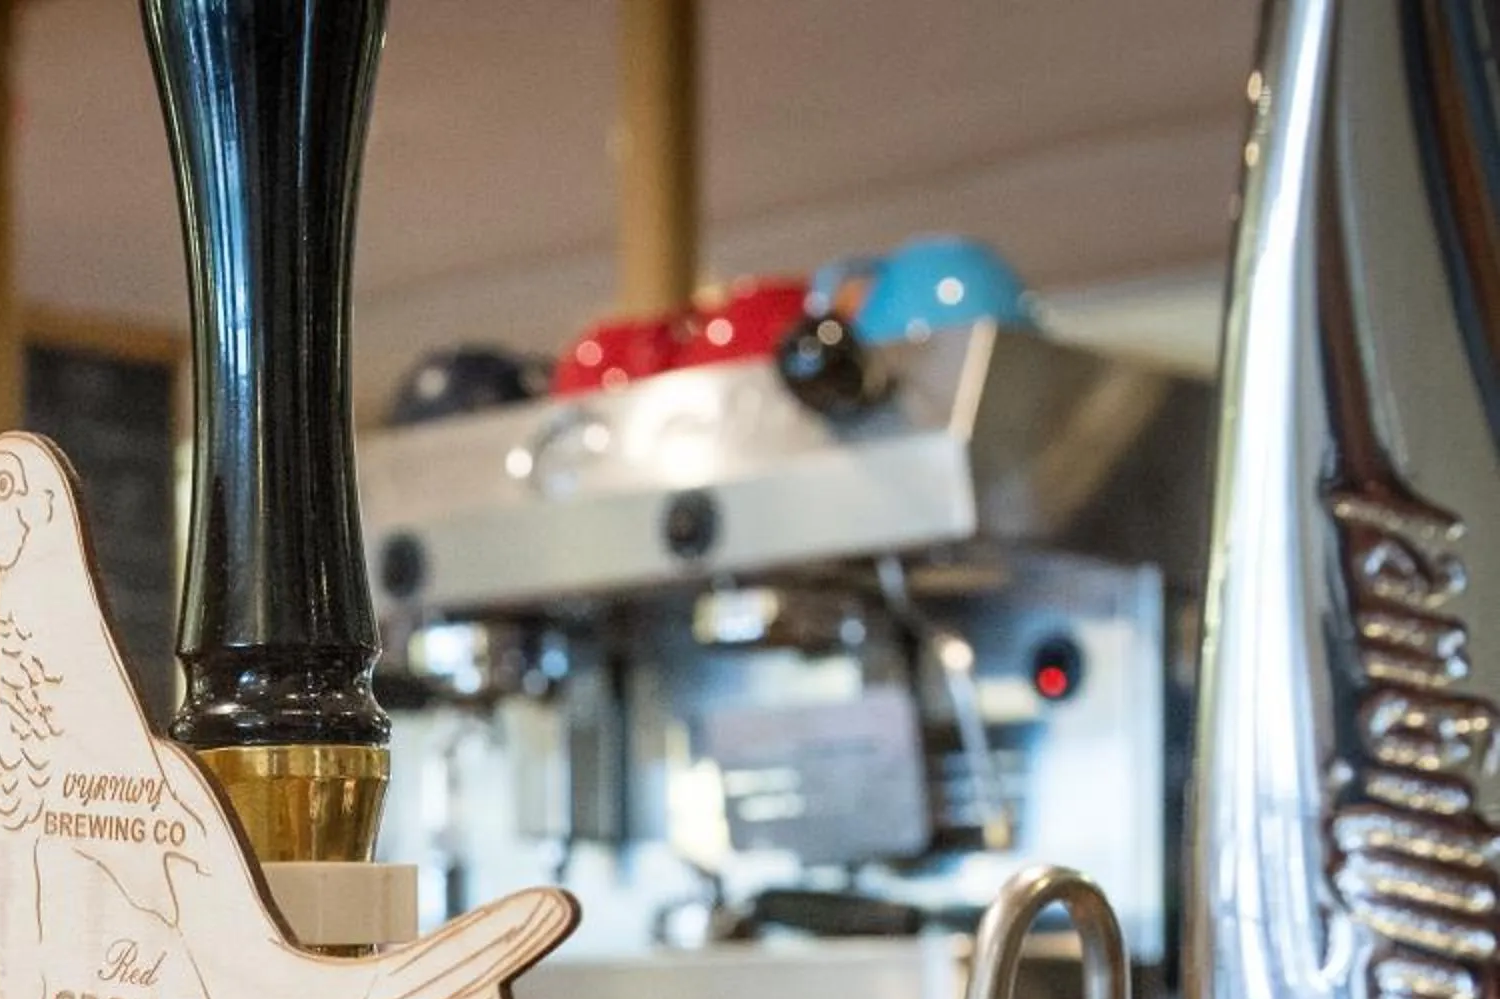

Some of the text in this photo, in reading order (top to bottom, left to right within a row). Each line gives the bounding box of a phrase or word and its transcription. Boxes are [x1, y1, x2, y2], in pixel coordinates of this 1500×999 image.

[43, 810, 186, 846] BREWING CO
[98, 938, 167, 986] Red
